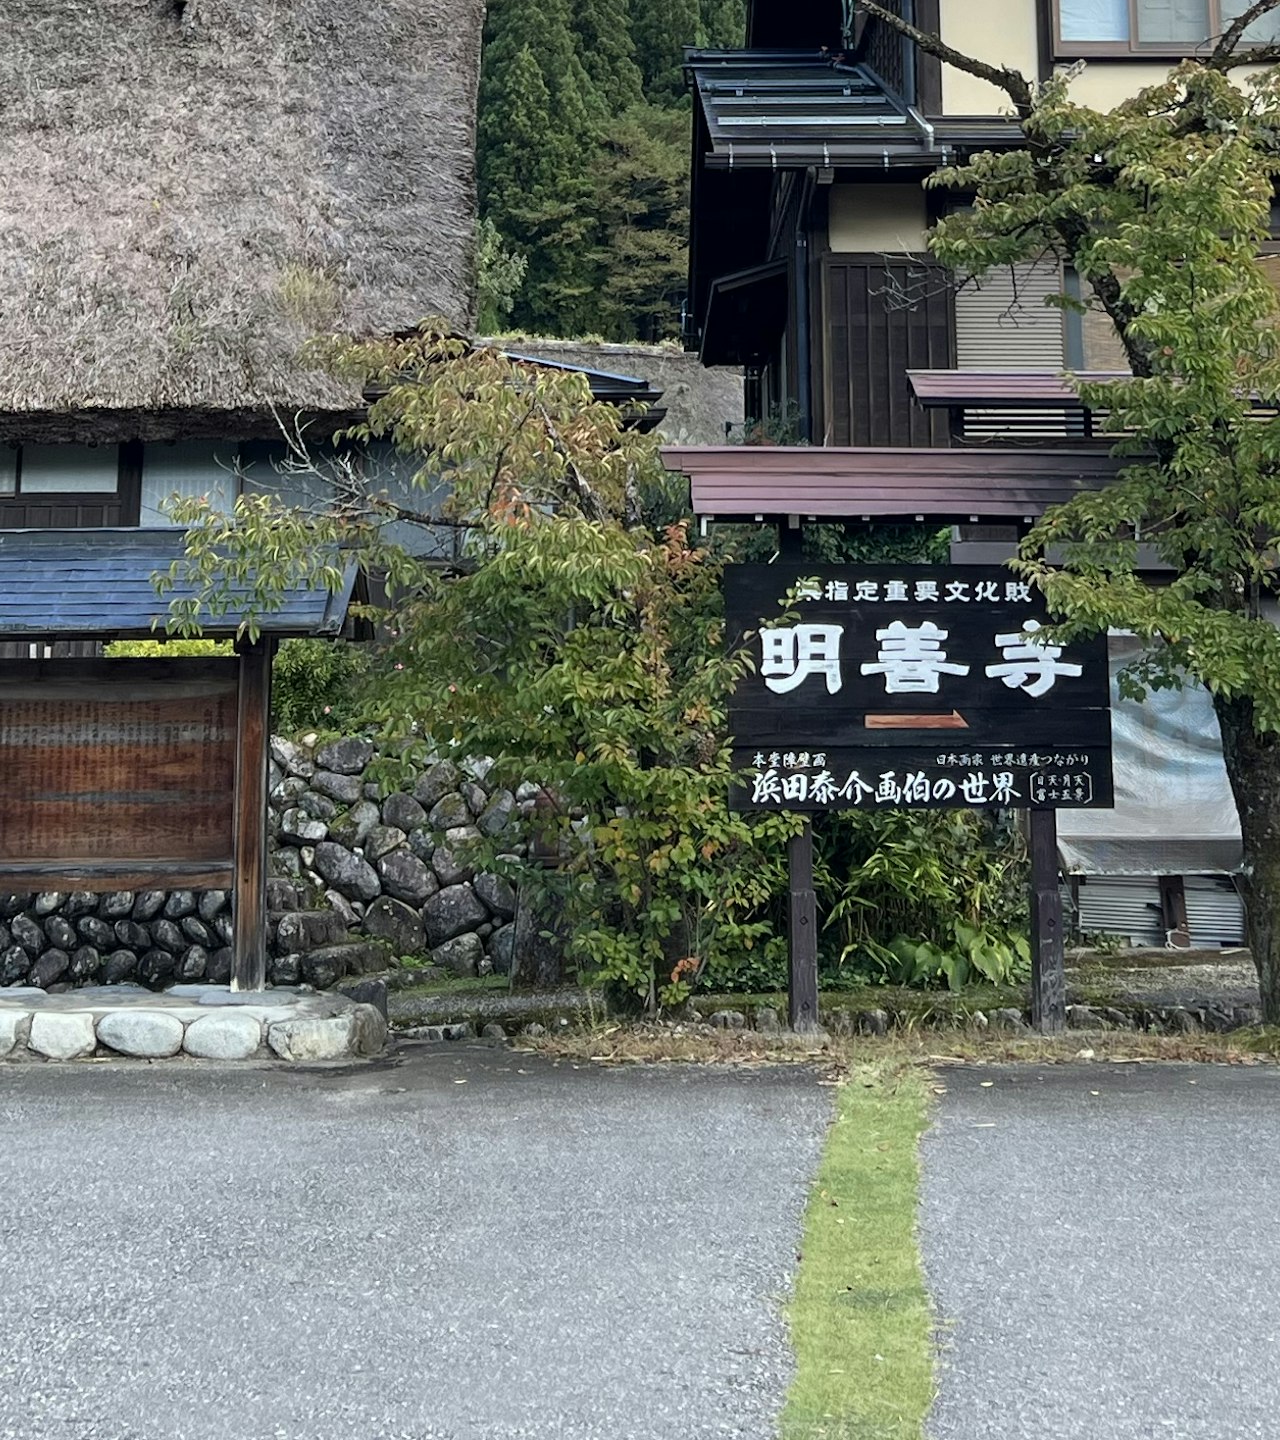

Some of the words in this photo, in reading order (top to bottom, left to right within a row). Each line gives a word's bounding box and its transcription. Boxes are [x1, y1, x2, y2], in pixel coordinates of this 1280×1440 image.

[760, 619, 1083, 698] 明善寺
[936, 753, 984, 767] 日本画家
[751, 768, 1022, 806] 浜田泰介画伯の世界
